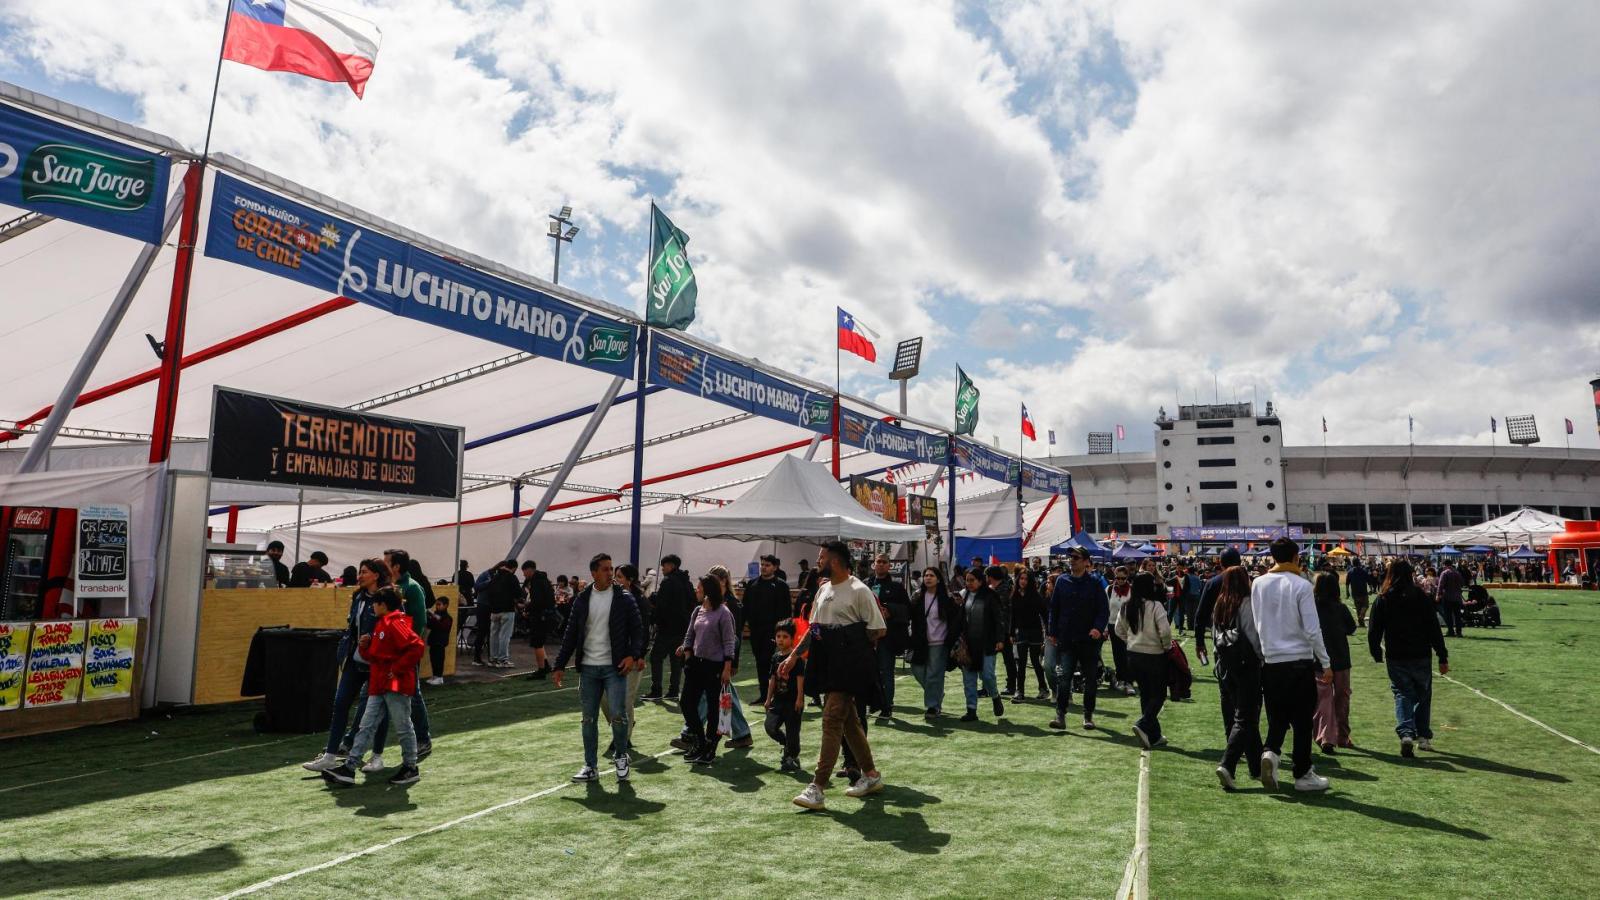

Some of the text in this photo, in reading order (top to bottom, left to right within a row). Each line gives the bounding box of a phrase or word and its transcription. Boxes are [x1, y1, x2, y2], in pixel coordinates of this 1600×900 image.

[32, 154, 145, 200] San Jorge
[234, 195, 267, 214] FONDA
[236, 233, 302, 269] DE CHILE
[375, 258, 567, 342] LUCHITO MARIO
[589, 333, 629, 356] San Jorge
[715, 370, 766, 404] LUCHITO
[767, 386, 800, 413] MARIO
[282, 412, 416, 461] TERREMOTOS
[882, 433, 908, 452] FONDA
[286, 452, 358, 480] EMPANADAS
[362, 462, 377, 480] DE
[380, 465, 416, 485] QUESO
[15, 509, 44, 525] Coca-Cola
[81, 519, 127, 534] CRISTAL
